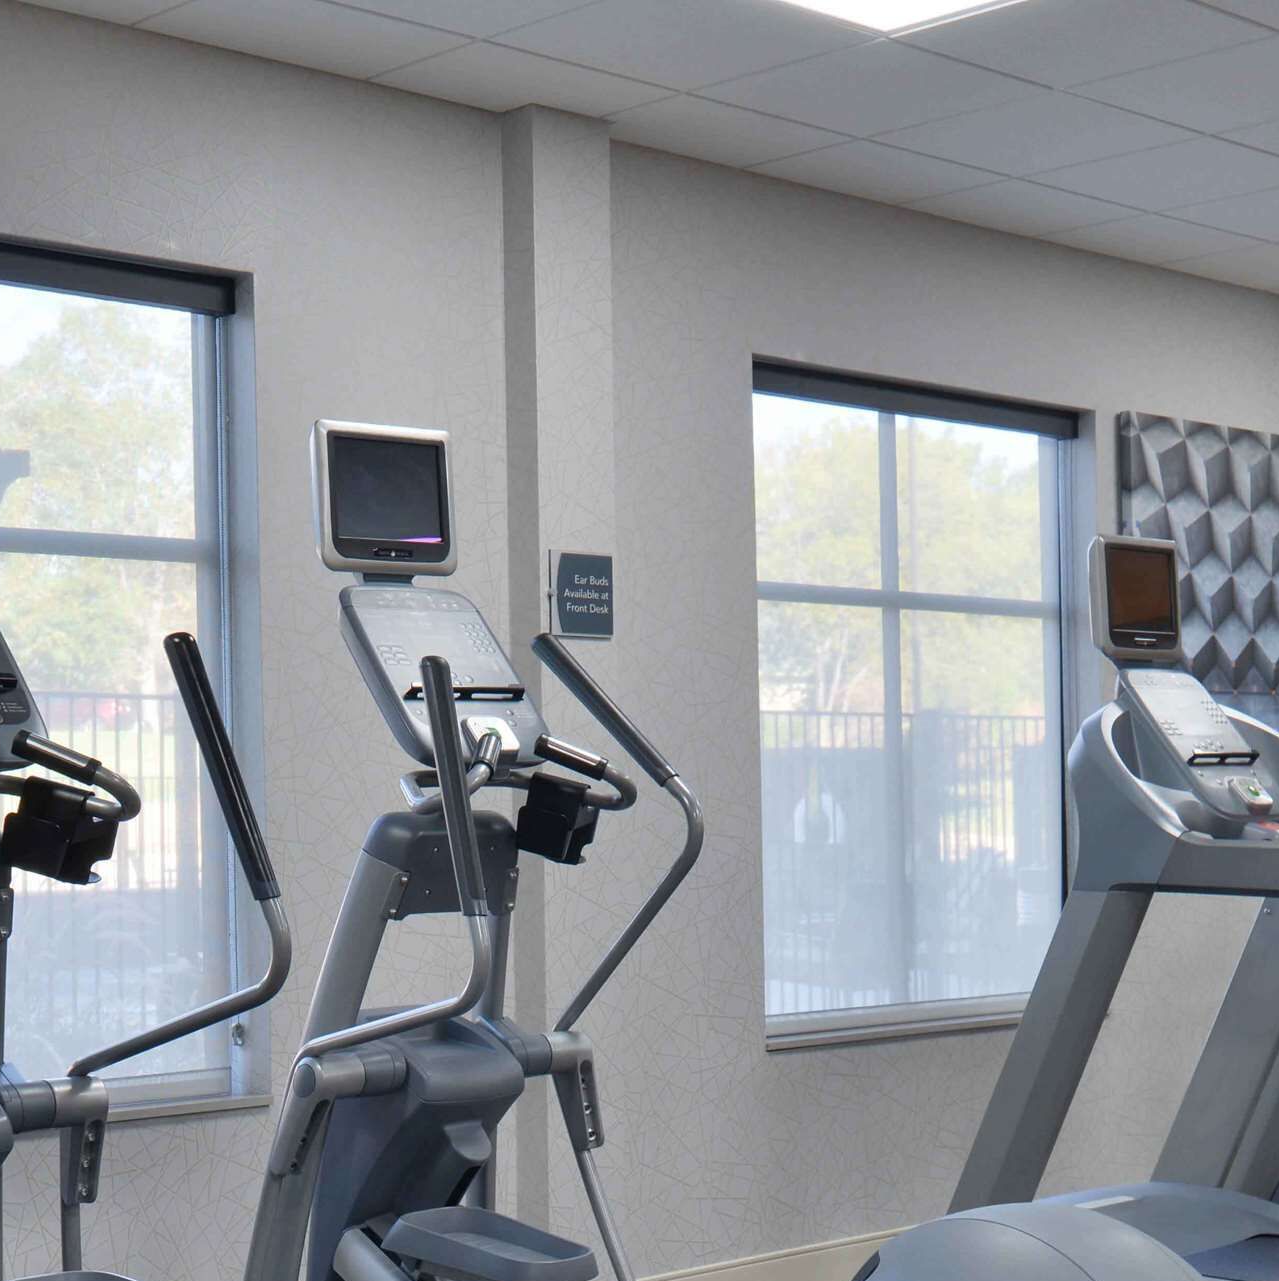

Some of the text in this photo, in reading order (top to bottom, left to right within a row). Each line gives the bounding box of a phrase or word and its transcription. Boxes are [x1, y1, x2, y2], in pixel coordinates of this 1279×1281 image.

[574, 574, 609, 586] Ear Buds
[564, 588, 609, 600] Available at
[566, 602, 609, 614] Front Desk
